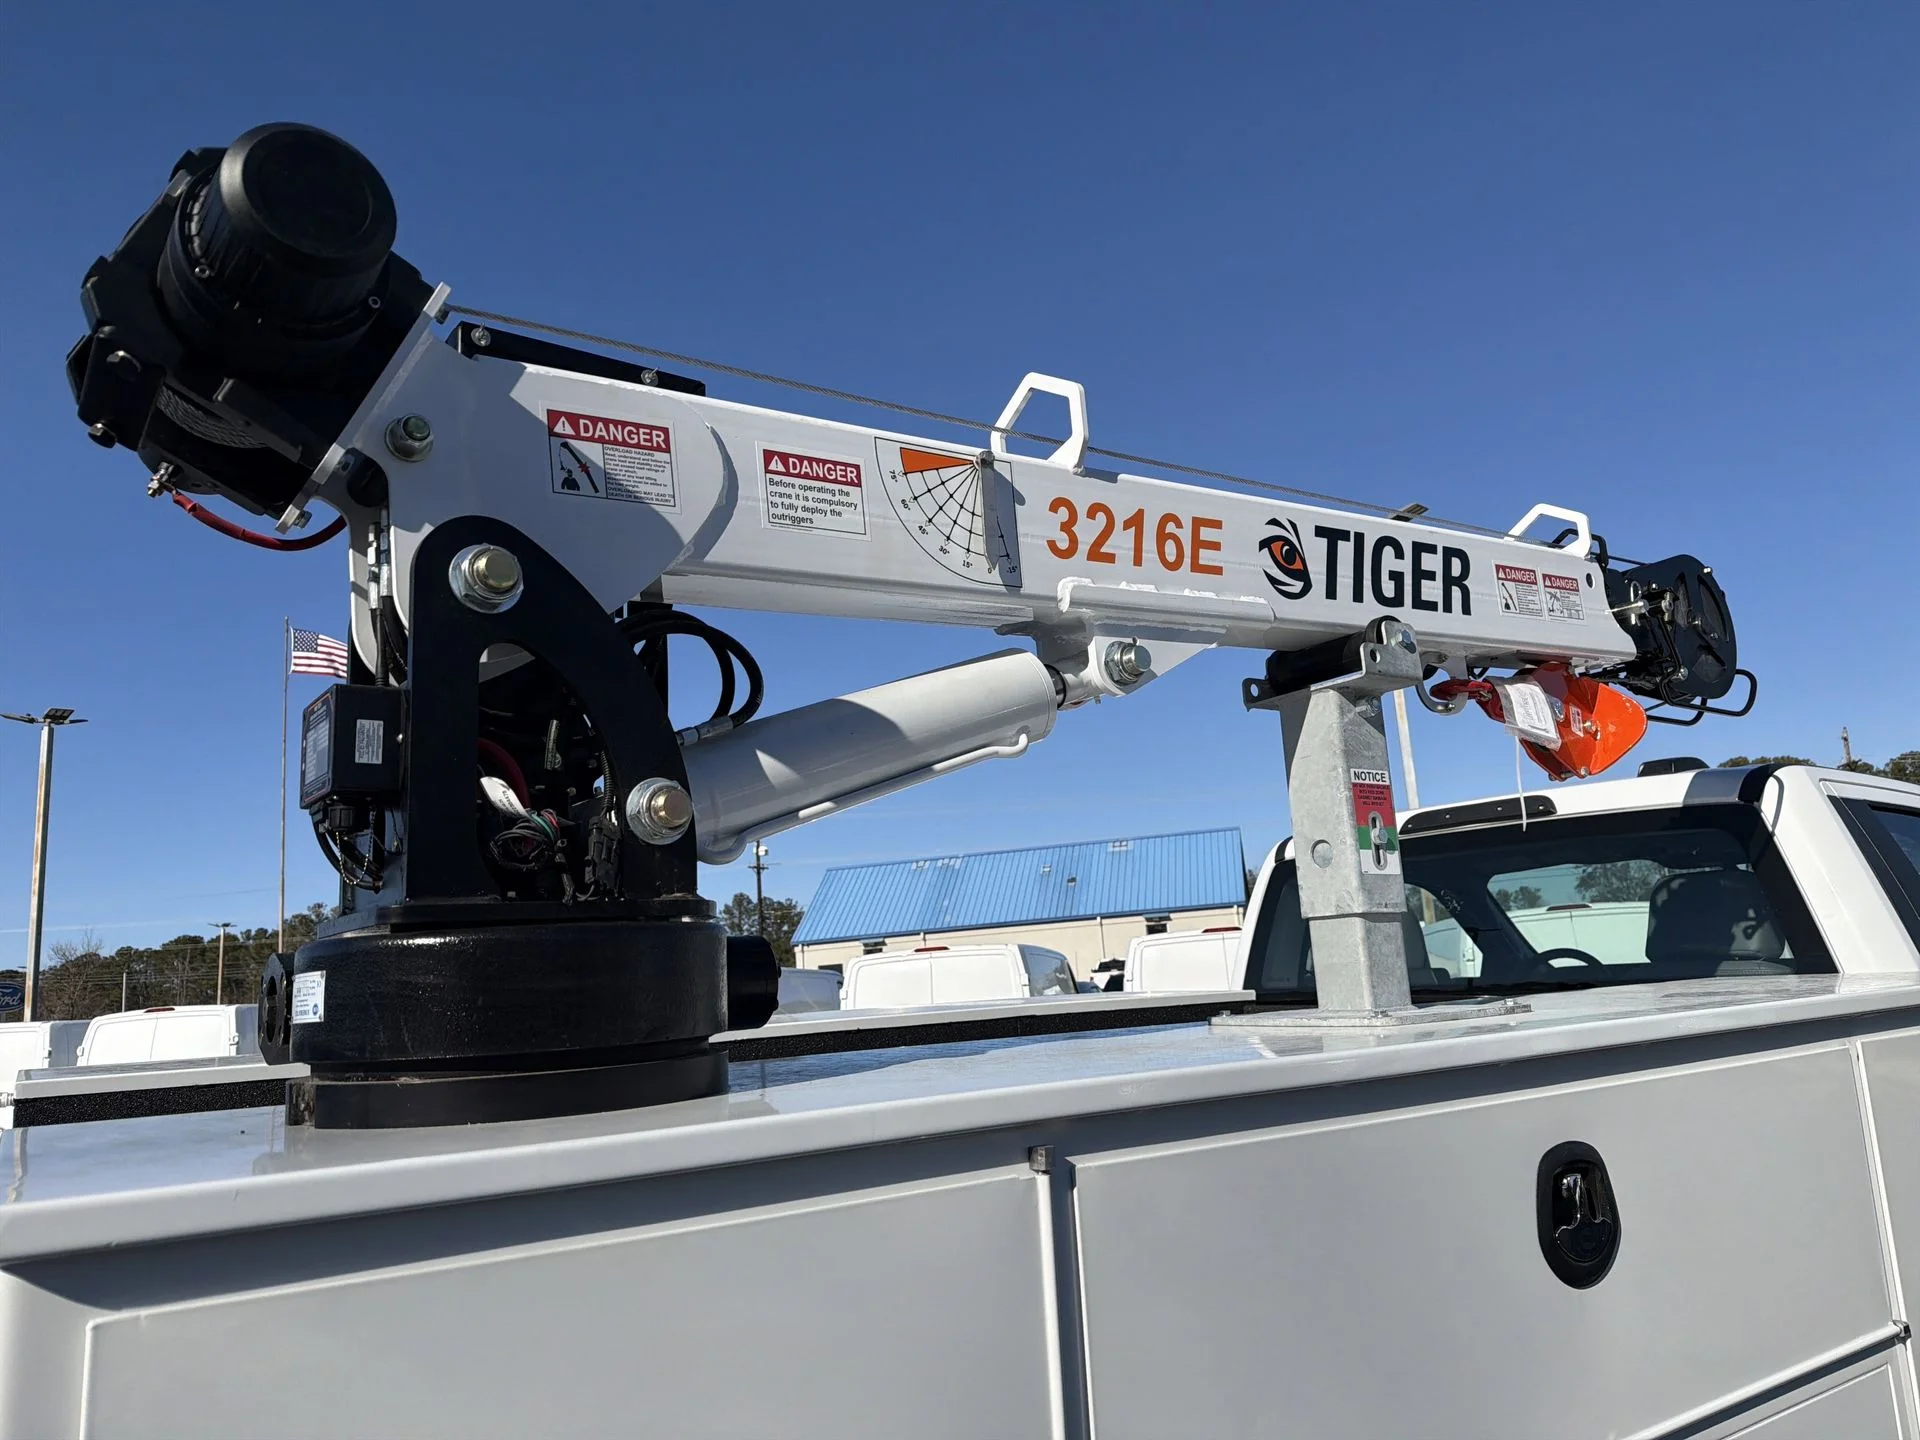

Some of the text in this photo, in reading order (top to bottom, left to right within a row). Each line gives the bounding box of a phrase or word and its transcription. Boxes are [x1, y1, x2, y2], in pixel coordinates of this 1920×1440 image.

[579, 419, 667, 448] DANGER
[789, 458, 858, 484] DANGER
[769, 478, 850, 497] Before operating the
[769, 490, 858, 510] crane it is compulsory
[781, 500, 798, 513] fully
[801, 504, 828, 517] deploy
[830, 509, 842, 517] the
[771, 512, 814, 524] outriggers
[1046, 496, 1224, 576] 3216E
[1314, 525, 1472, 616] TIGER
[1505, 568, 1536, 583] DANGER
[1552, 578, 1578, 590] DANGER
[1354, 770, 1386, 782] NOTICE
